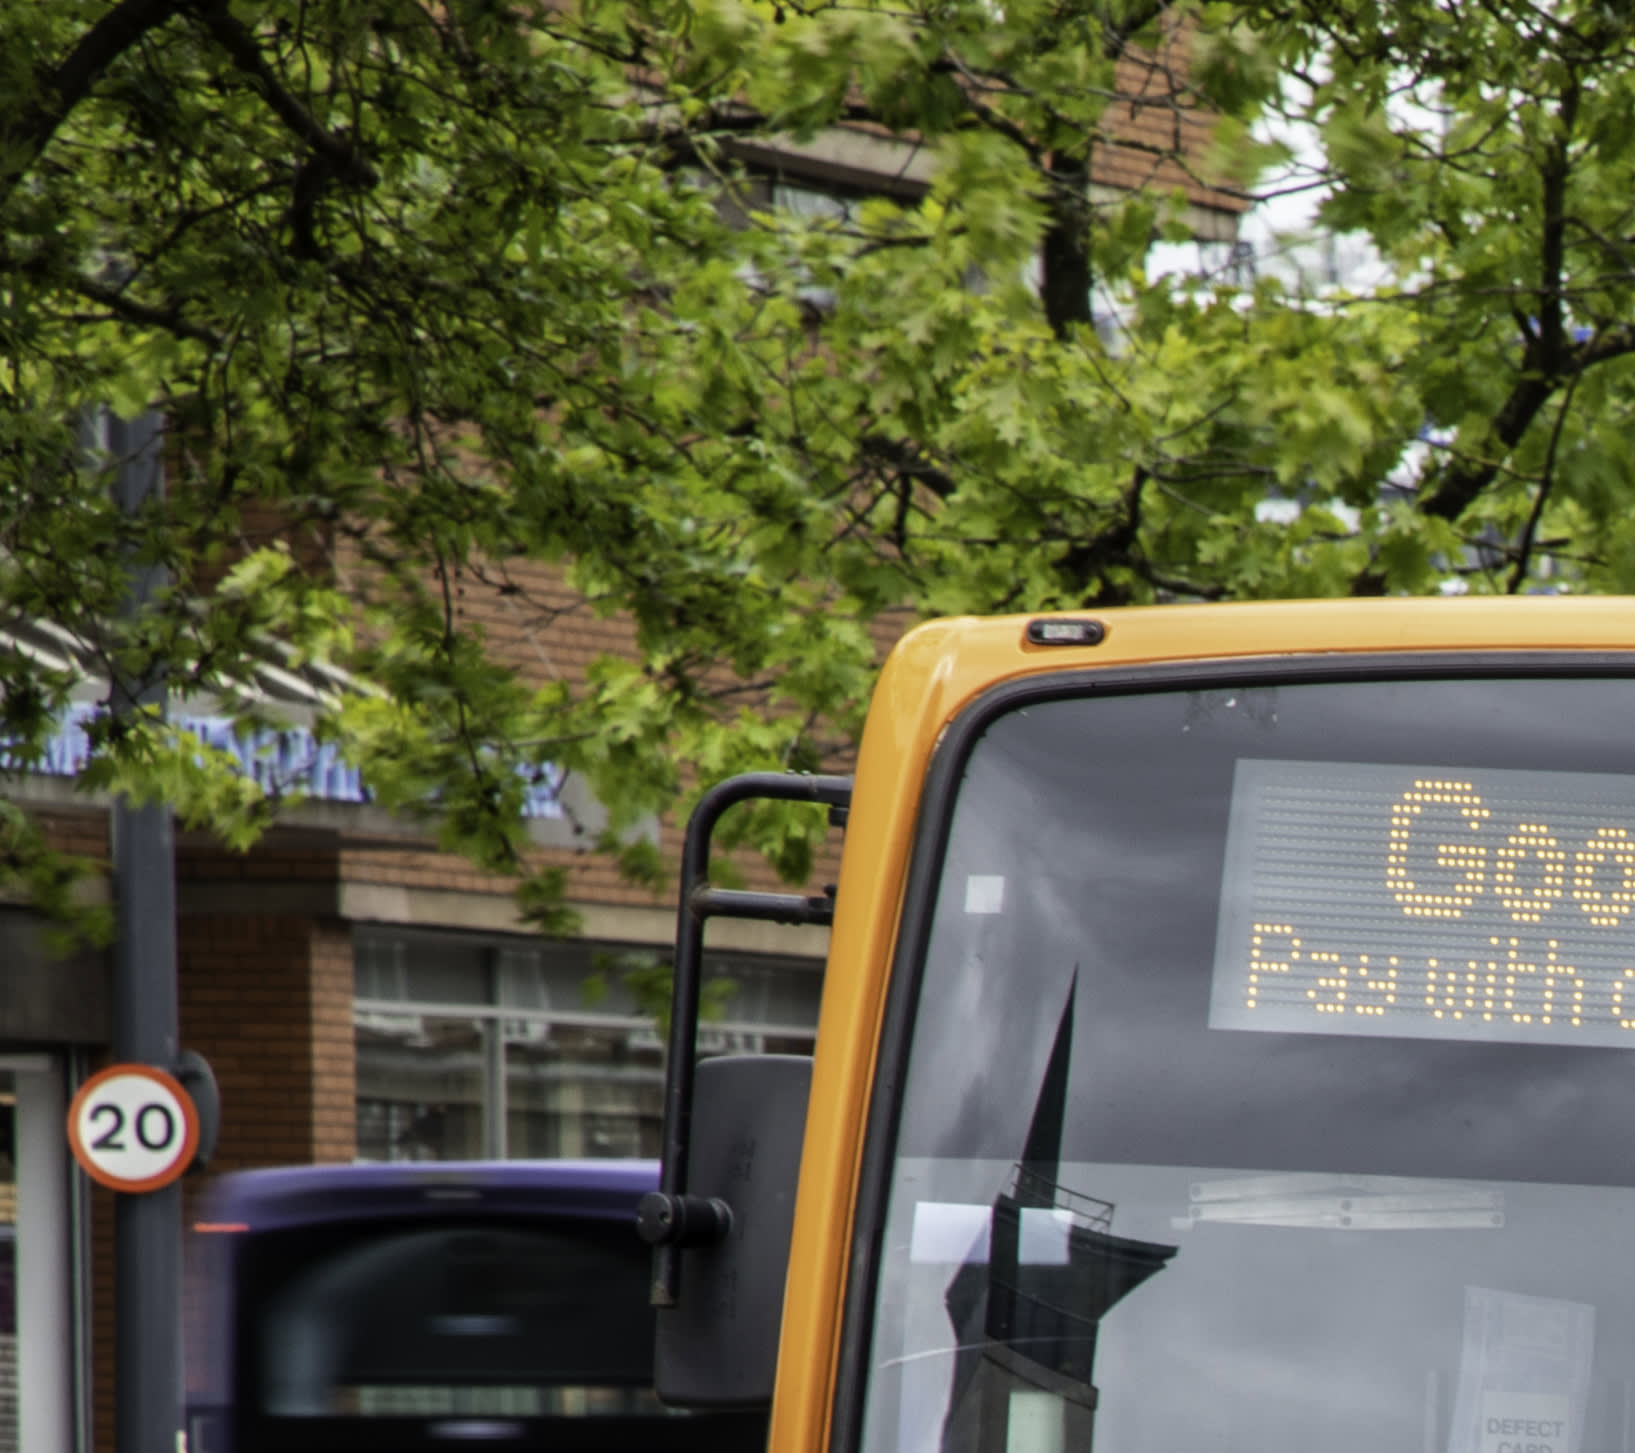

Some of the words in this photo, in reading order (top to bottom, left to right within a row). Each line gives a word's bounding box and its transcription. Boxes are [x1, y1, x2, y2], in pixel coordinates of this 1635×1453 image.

[1247, 923, 1398, 1016] Pay
[1426, 936, 1584, 1027] with
[89, 1103, 175, 1151] 20
[1486, 1417, 1564, 1438] DEFECT
